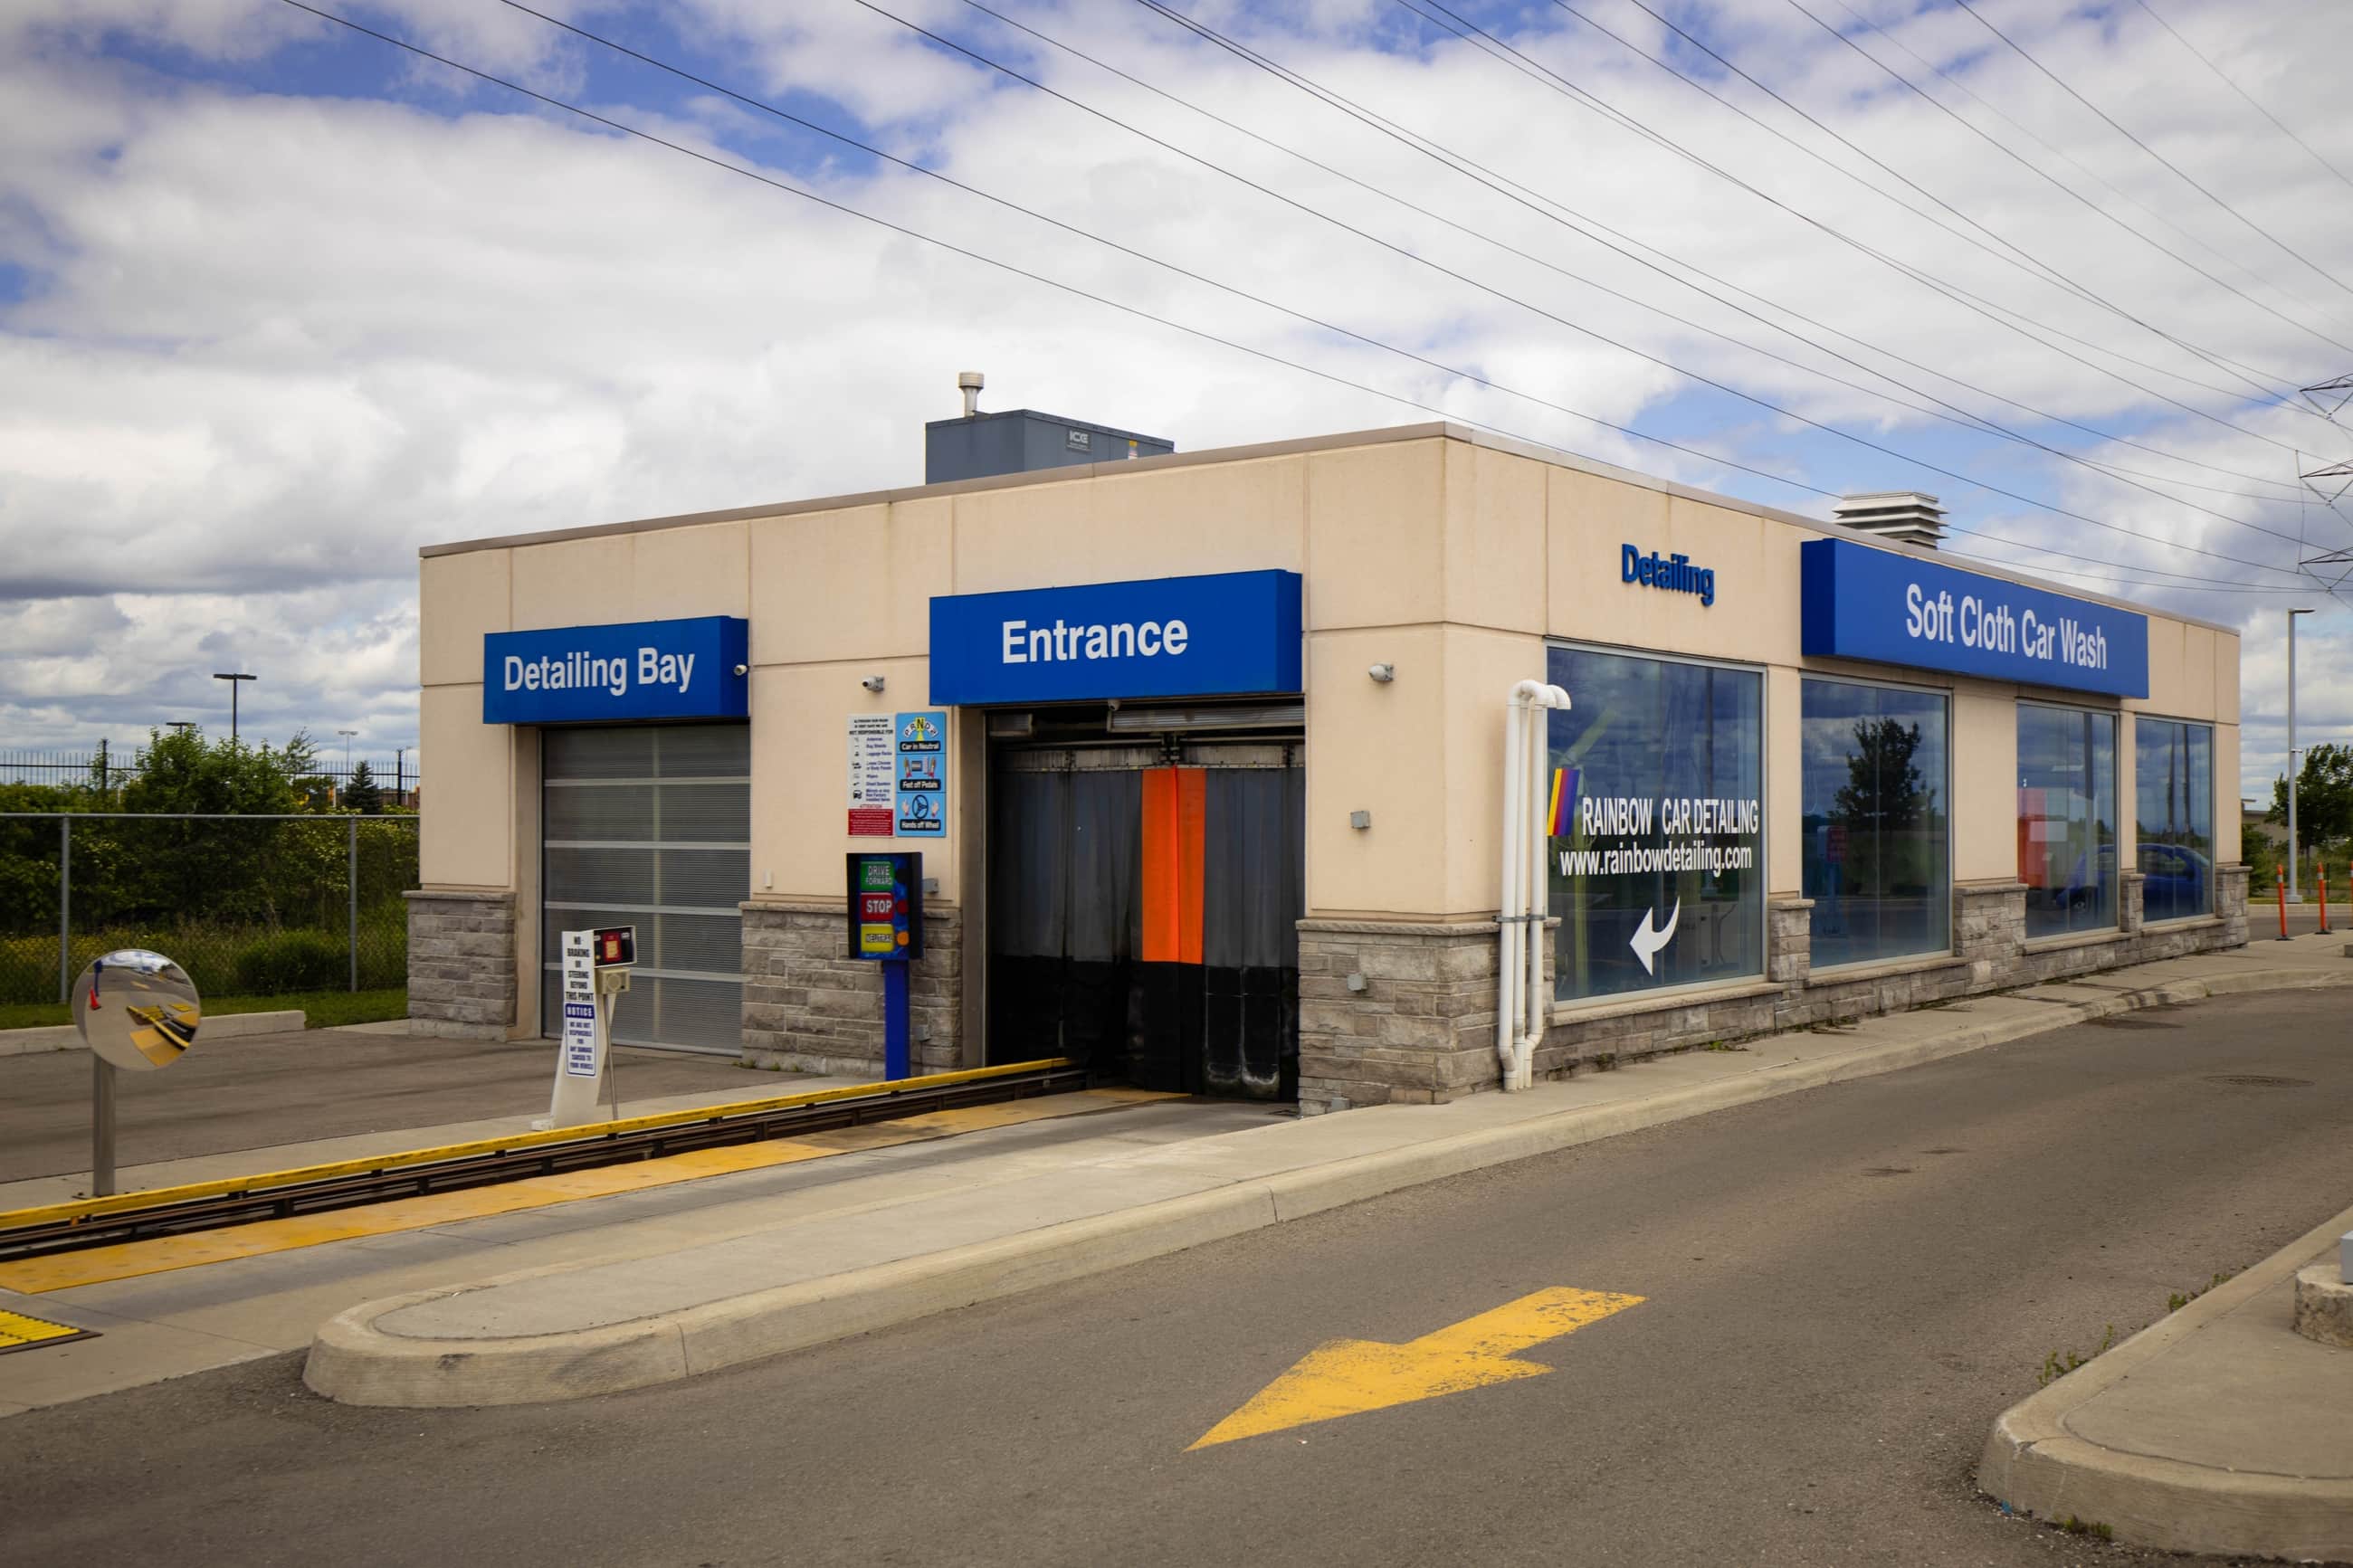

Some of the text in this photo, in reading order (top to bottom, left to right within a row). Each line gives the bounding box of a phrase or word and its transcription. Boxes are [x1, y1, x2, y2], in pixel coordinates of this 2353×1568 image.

[1622, 543, 1715, 608] Detailing
[1003, 619, 1188, 664] Entrance
[1906, 584, 2107, 670] Soft Cloth Car Wash
[504, 647, 696, 697] Detailing Bay
[1582, 796, 1759, 836] RAINBOW CAR DETAILING
[868, 865, 891, 876] DRIVE
[1560, 840, 1753, 878] www.rainbowdetailing.com
[867, 899, 892, 913] STOP
[567, 948, 590, 958] BRAKING
[566, 992, 594, 1001] THIS POINT
[567, 1006, 592, 1017] NOTICE
